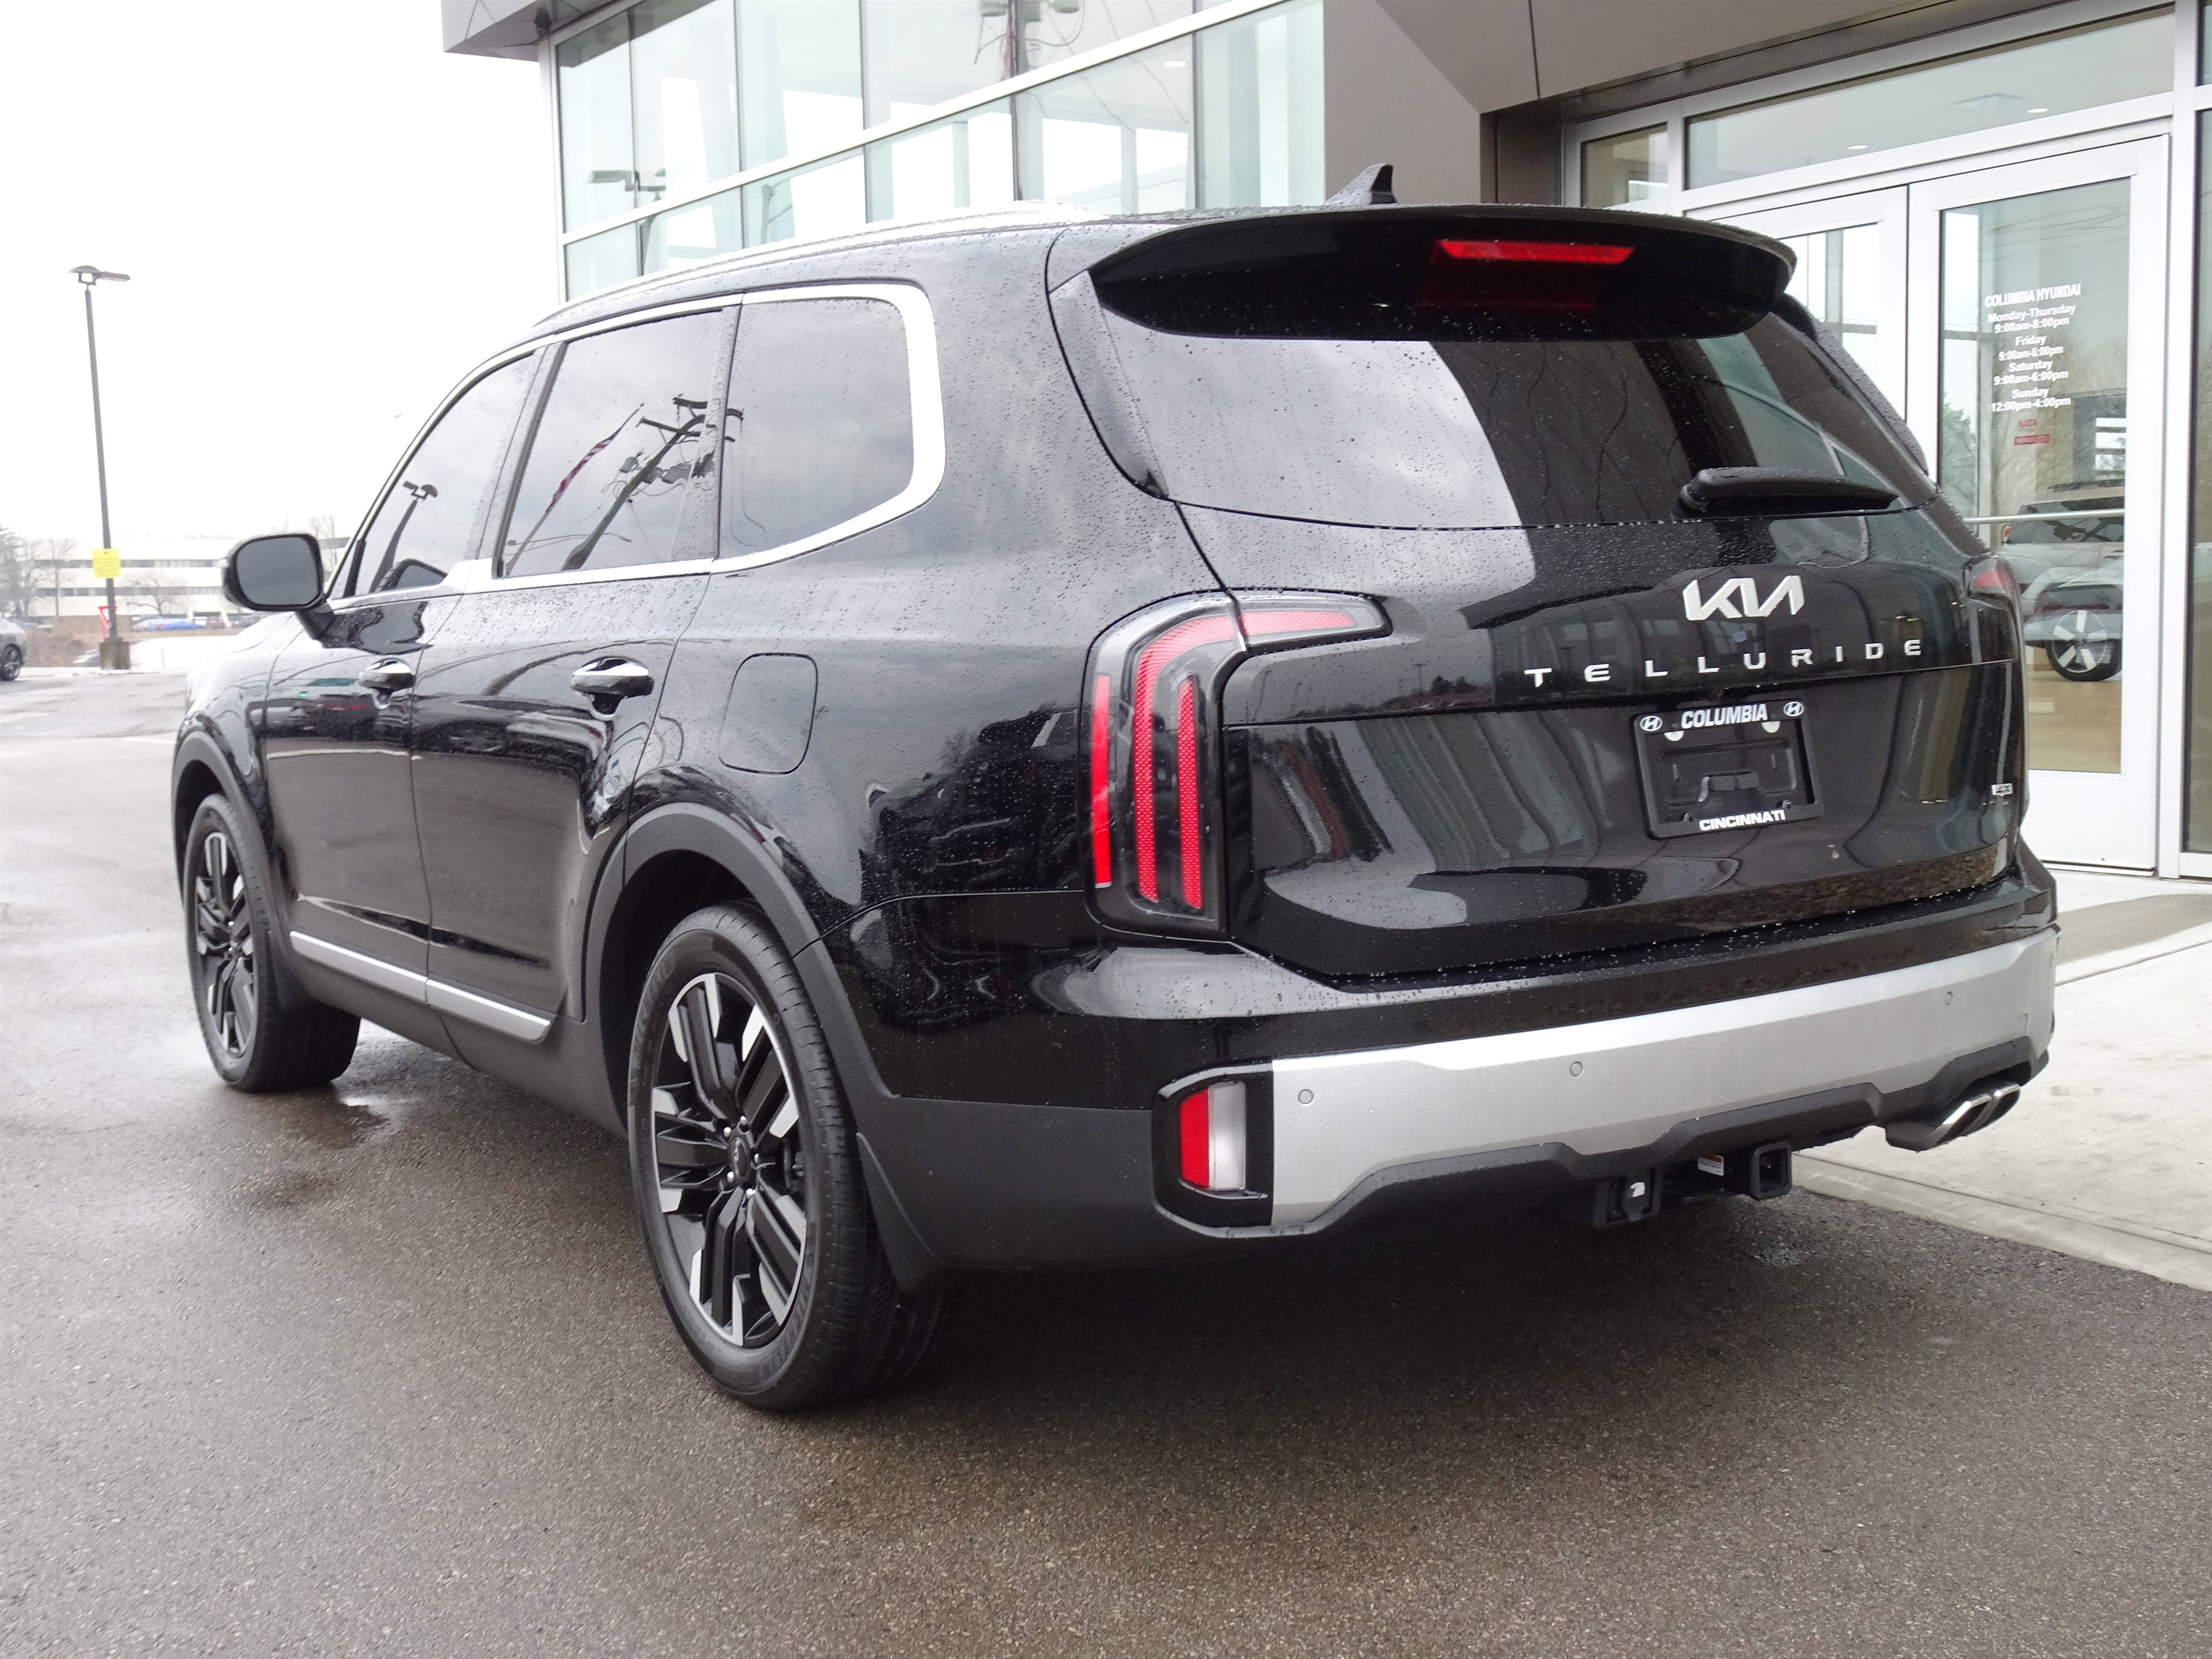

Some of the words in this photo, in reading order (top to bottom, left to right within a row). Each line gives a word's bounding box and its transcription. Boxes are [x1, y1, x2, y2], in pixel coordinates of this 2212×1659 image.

[1985, 289, 2036, 308] COLUMBIA
[2036, 283, 2081, 301] HYUNDAI
[1988, 304, 2076, 323] Monday-Thursday
[2015, 334, 2047, 347] Friday
[2008, 360, 2053, 373] Saturday
[2011, 387, 2049, 399] Sunday
[1683, 575, 1805, 621] KIA
[1524, 639, 1921, 687] TELLURIDE
[1681, 703, 1768, 729] COLUMBIA
[1699, 810, 1786, 831] CINCINNATI
